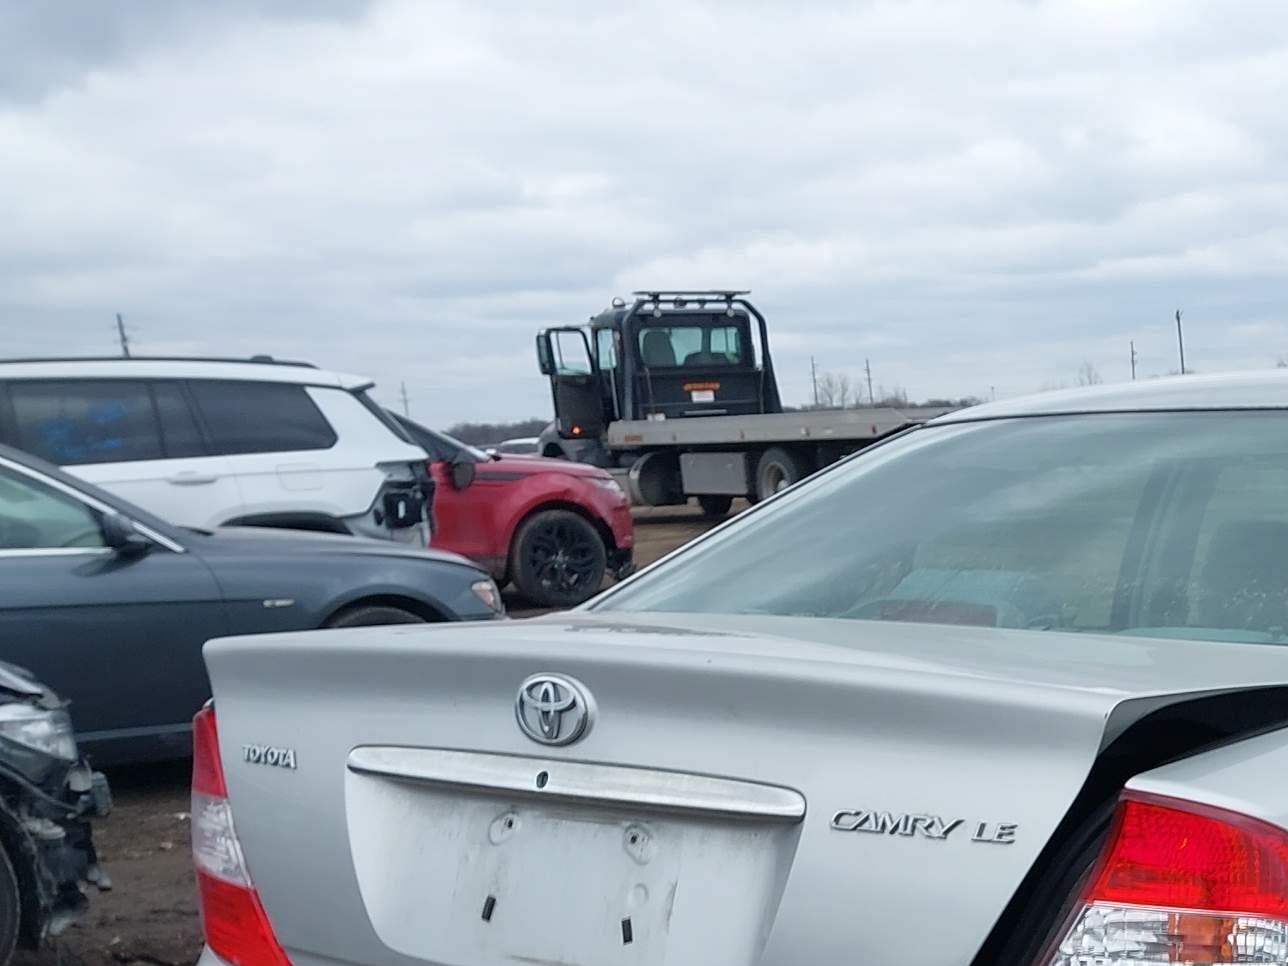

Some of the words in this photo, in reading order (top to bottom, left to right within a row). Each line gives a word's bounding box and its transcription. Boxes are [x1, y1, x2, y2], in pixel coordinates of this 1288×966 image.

[241, 744, 297, 770] TOYOTA
[830, 808, 966, 840] CAMRY
[970, 820, 1018, 844] LE
